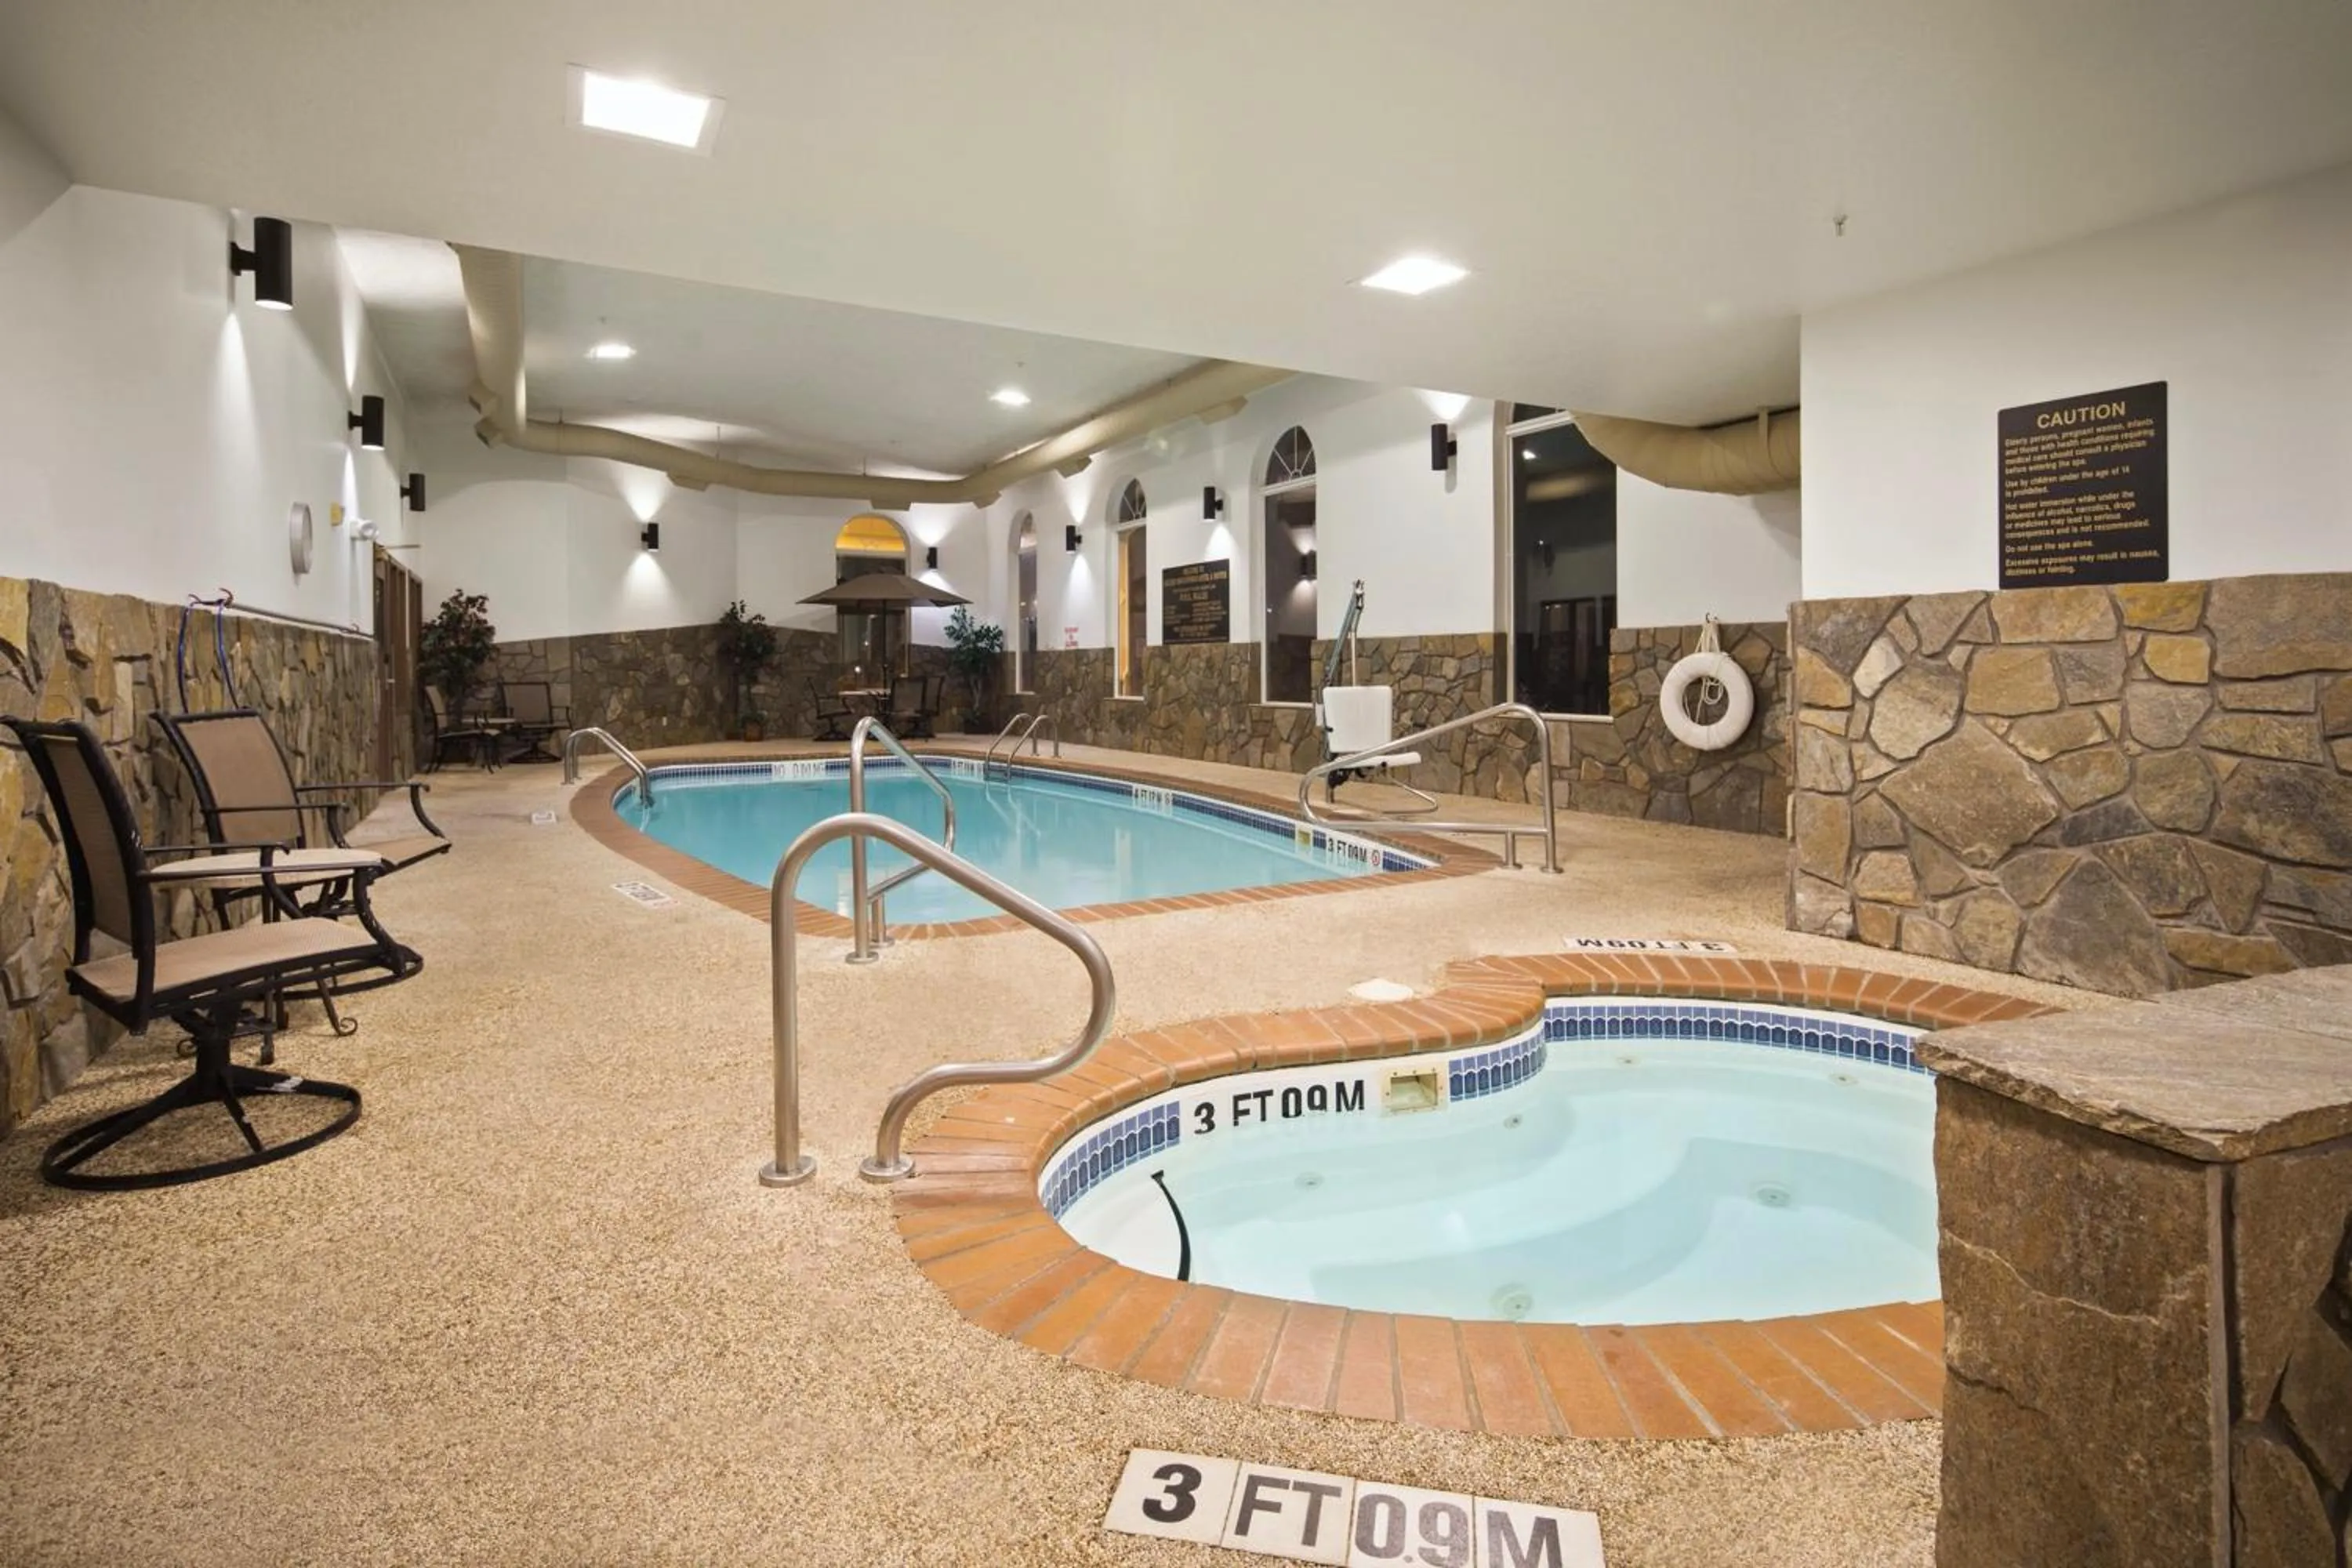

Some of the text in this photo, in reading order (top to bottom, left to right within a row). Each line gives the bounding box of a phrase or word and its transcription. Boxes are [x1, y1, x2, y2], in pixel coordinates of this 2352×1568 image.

[2037, 401, 2125, 429] CAUTION
[2056, 438, 2079, 448] health
[2080, 434, 2118, 445] conditions
[2061, 426, 2093, 440] pregnant
[2005, 455, 2031, 465] medical
[2049, 448, 2073, 459] should
[2110, 440, 2147, 452] physician
[2030, 476, 2057, 485] children
[2059, 473, 2079, 481] under
[2095, 470, 2109, 478] age
[2111, 466, 2119, 475] of
[2097, 492, 2119, 501] under
[2005, 511, 2035, 520] influence
[2113, 501, 2136, 510] drugs
[2096, 551, 2118, 560] result
[1327, 837, 1334, 852] 3
[1577, 938, 1603, 948] M
[1194, 1102, 1216, 1134] 3
[1232, 1089, 1274, 1127] FT
[1335, 1080, 1365, 1112] M
[1142, 1463, 1202, 1523] 3
[1233, 1475, 1341, 1547] FT
[1488, 1508, 1563, 1568] M
